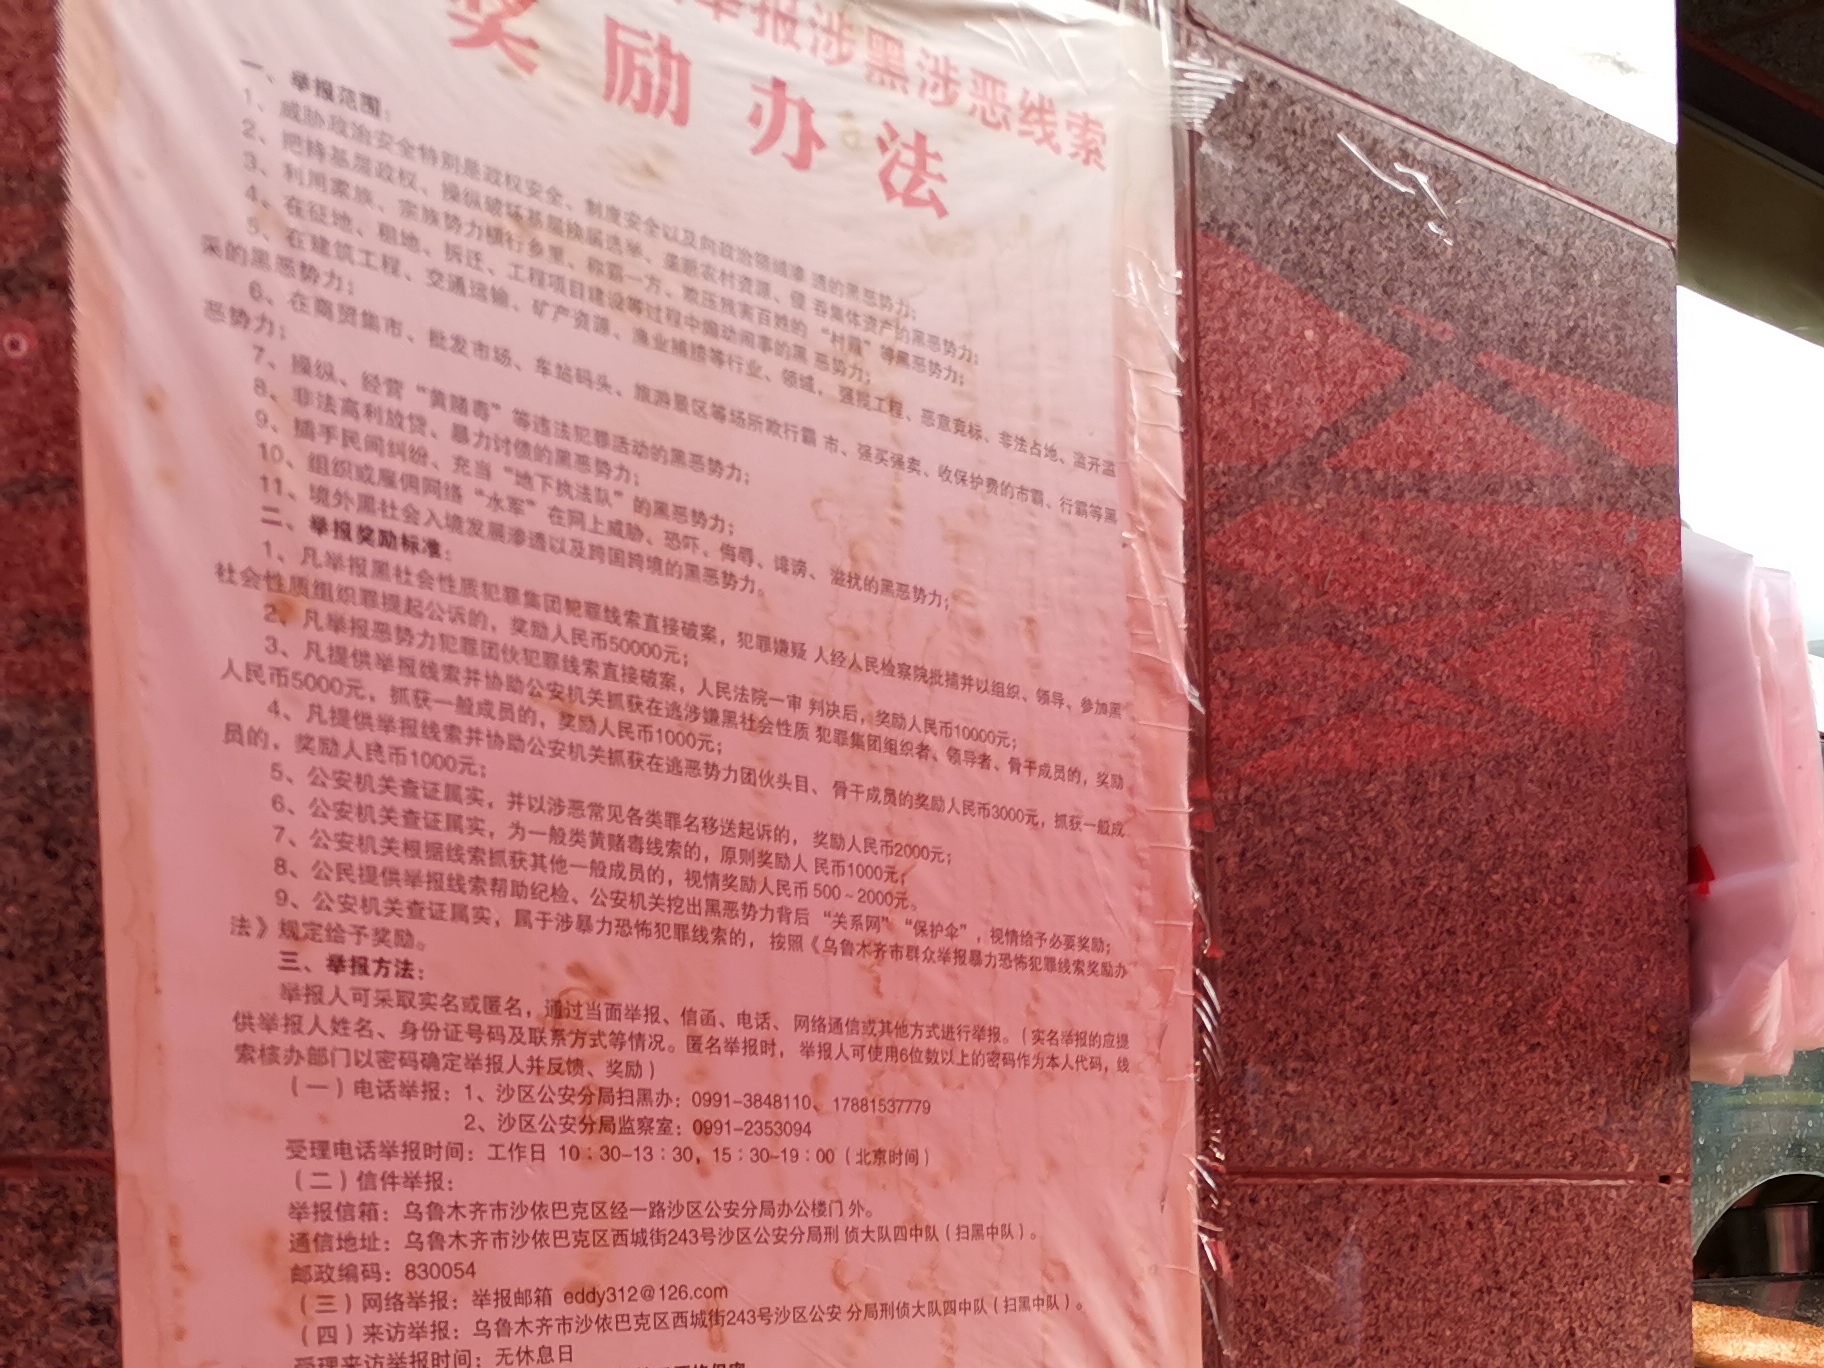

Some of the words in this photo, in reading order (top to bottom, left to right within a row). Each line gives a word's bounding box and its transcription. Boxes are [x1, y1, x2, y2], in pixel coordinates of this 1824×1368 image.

[445, 0, 950, 220] 奖励办法
[277, 950, 426, 981] 三、举报方法：
[290, 1261, 477, 1286] 邮政编码：830054
[563, 1283, 728, 1308] eddy312@126.com
